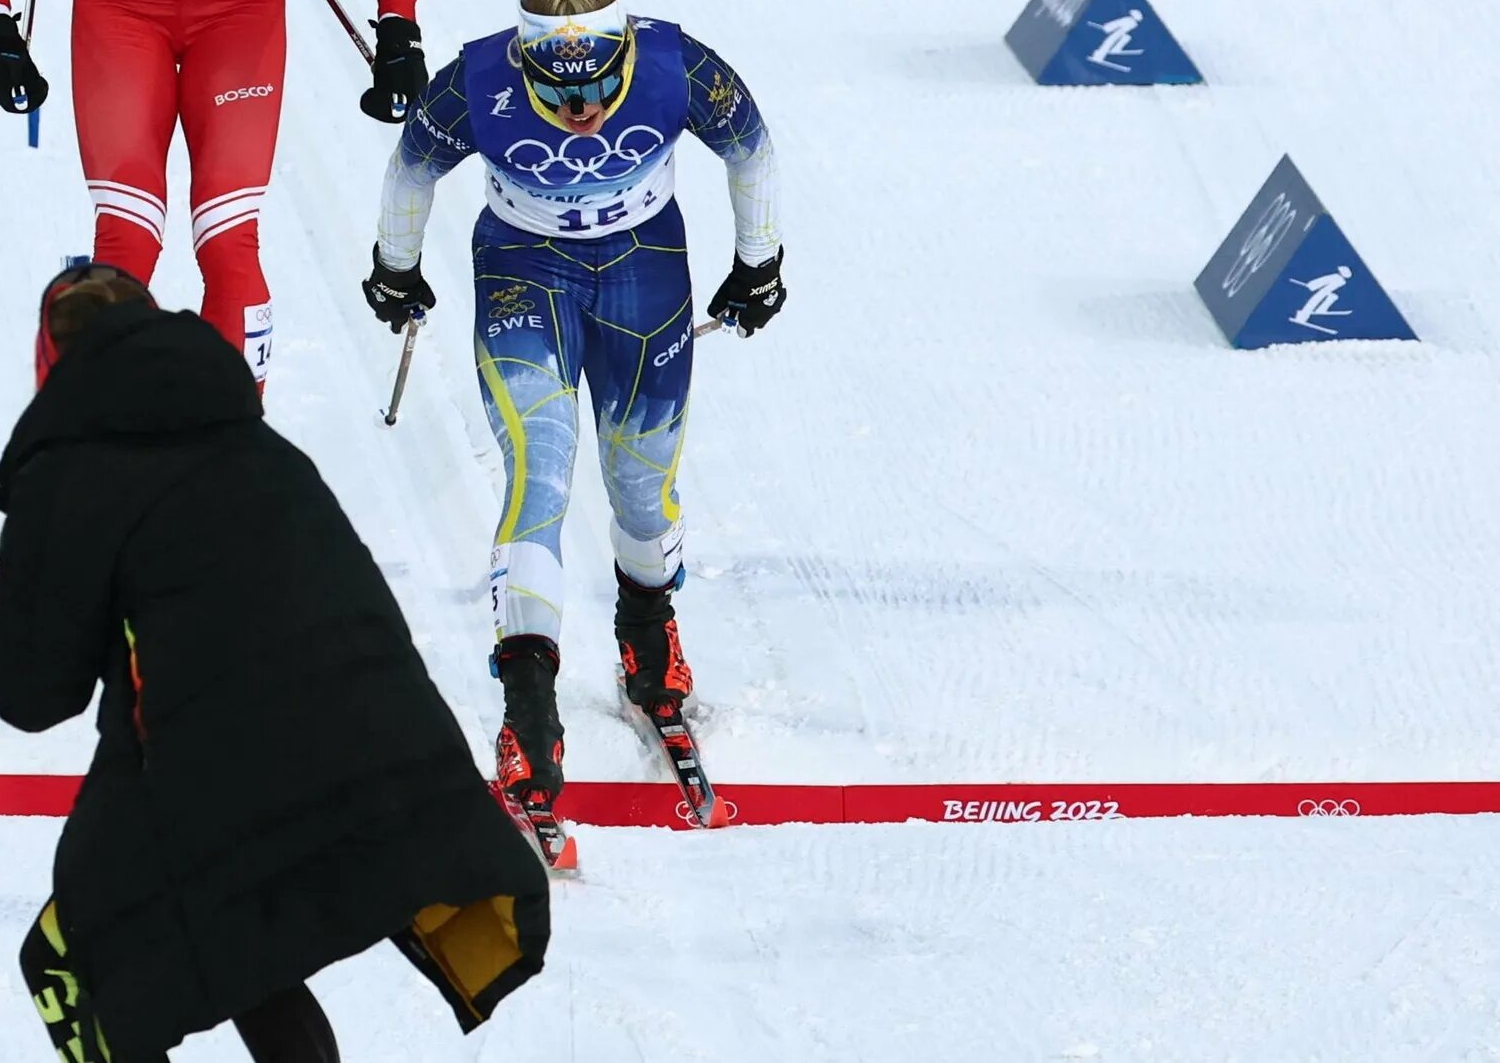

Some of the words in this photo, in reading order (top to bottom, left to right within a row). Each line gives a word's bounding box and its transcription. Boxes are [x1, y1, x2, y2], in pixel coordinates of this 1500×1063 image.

[552, 58, 598, 74] SWE
[417, 108, 454, 145] CRAFT
[556, 200, 629, 231] 15
[487, 315, 544, 338] SWE
[653, 315, 693, 367] CRAF
[491, 585, 499, 613] 5
[943, 800, 1042, 822] BEIJING
[1050, 801, 1124, 820] 2022
